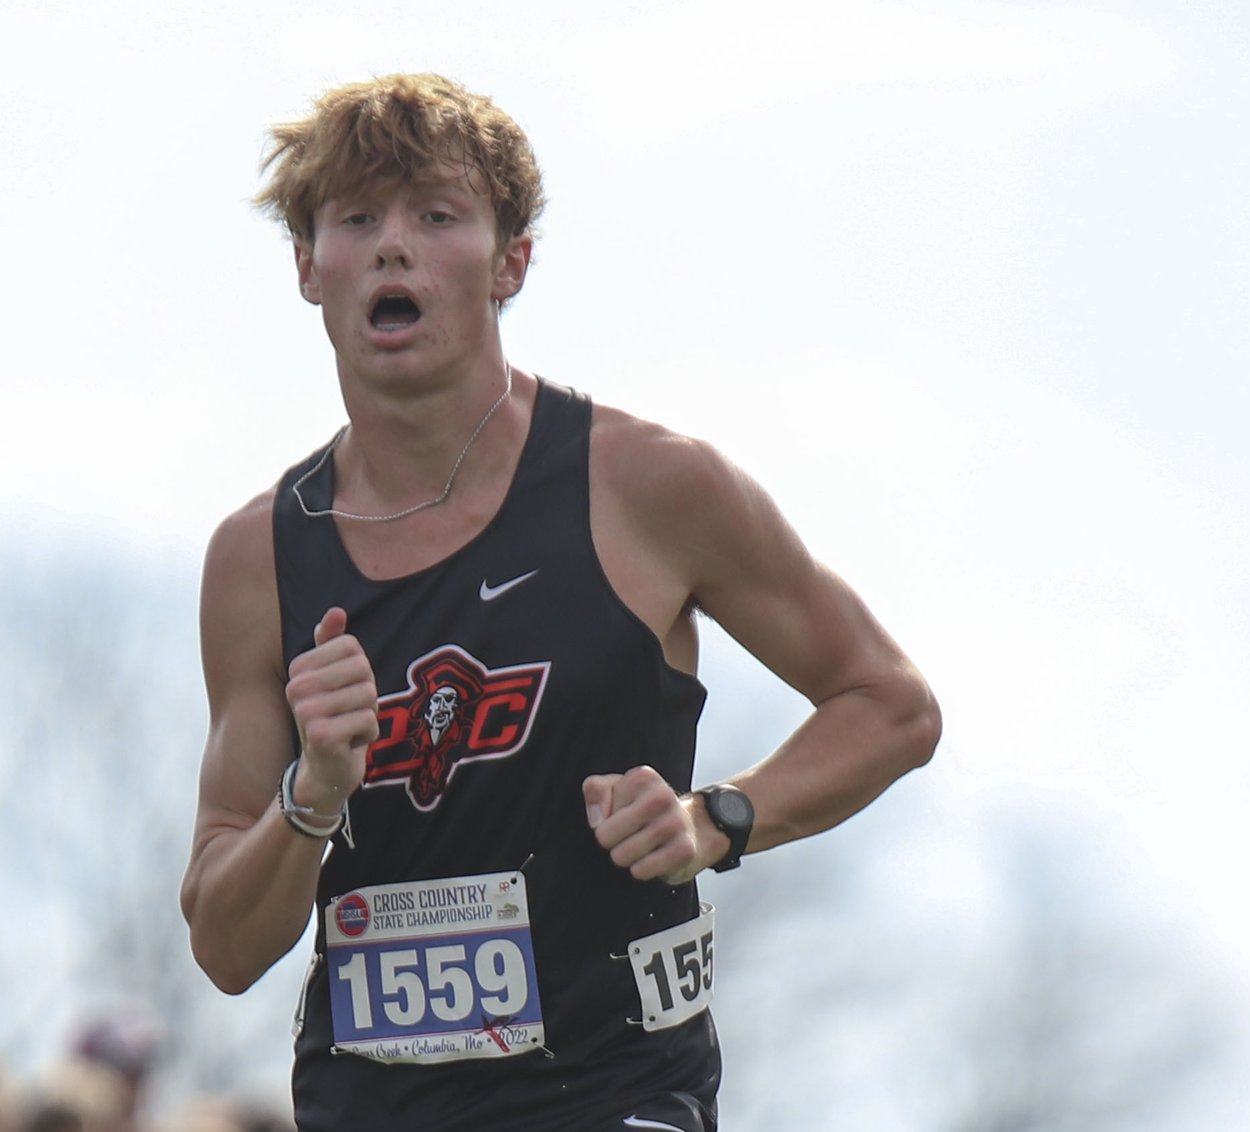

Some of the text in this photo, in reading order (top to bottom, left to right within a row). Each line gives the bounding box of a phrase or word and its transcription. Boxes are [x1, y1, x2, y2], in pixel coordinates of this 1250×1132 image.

[373, 883, 487, 913] CROSS COUNTRY
[373, 904, 493, 930] STATE CHAMPIONSHIP
[338, 939, 528, 1029] 1559
[376, 1043, 401, 1059] Creek
[463, 1034, 483, 1050] Mo
